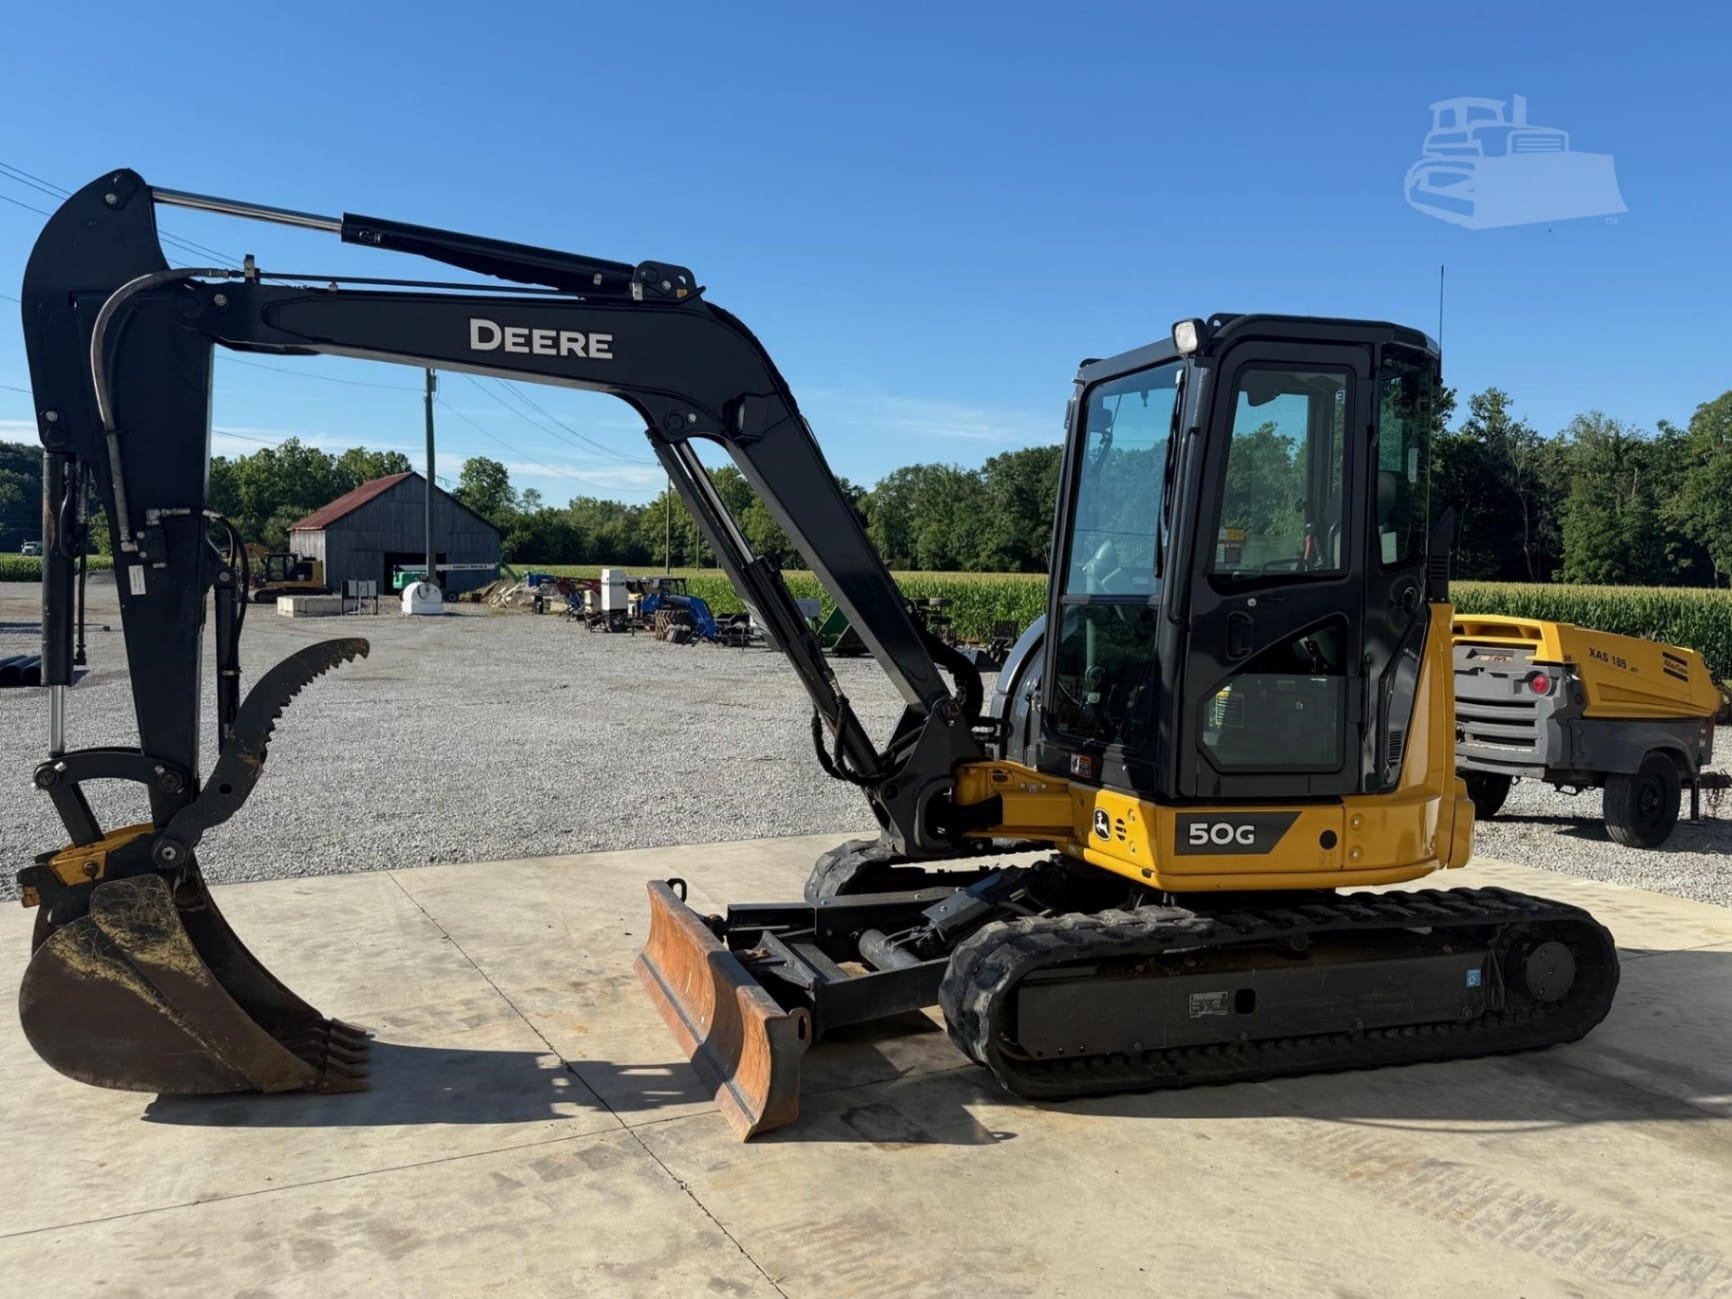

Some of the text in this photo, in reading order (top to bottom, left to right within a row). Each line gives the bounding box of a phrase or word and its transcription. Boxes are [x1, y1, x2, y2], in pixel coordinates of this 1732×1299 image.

[470, 318, 613, 359] DEERE
[1589, 647, 1609, 663] XAS
[1612, 656, 1627, 669] 185
[1189, 822, 1255, 845] 50G
